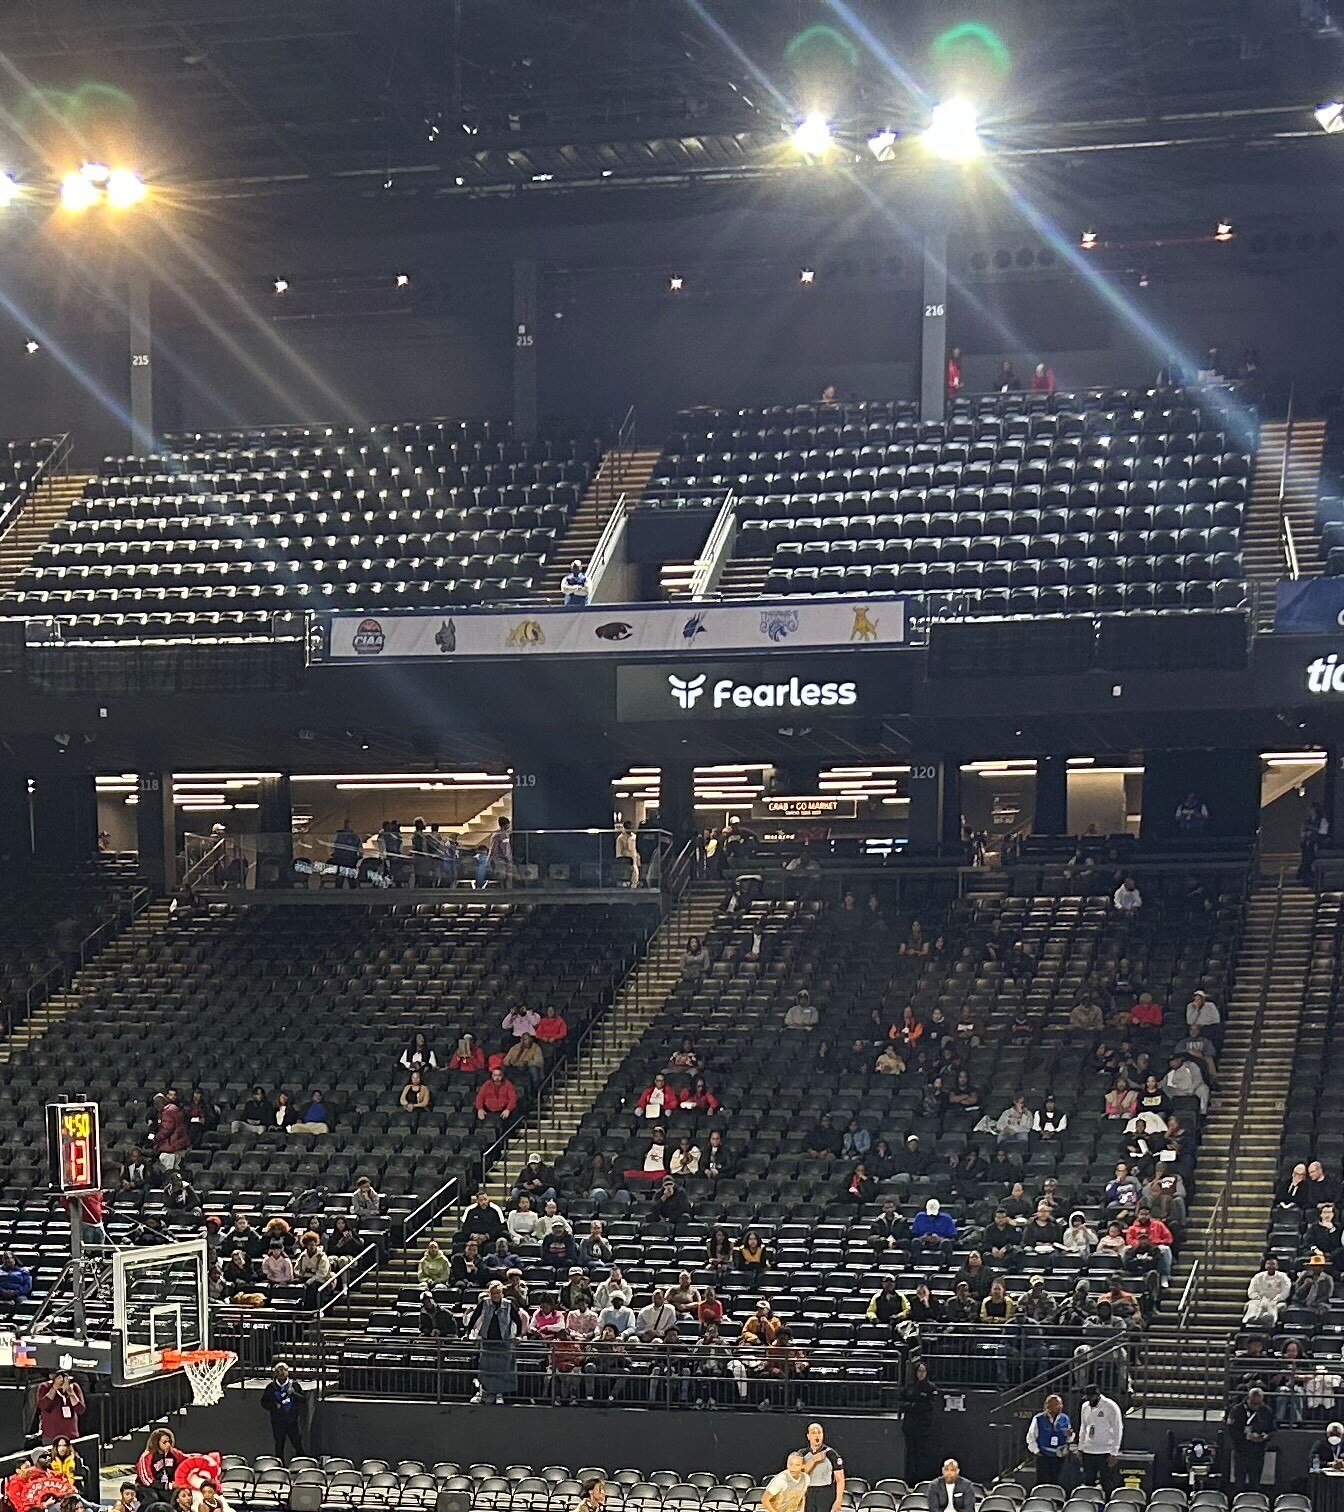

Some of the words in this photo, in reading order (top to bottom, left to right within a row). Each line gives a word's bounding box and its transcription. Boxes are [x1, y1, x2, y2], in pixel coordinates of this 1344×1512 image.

[924, 303, 945, 317] 216
[516, 335, 534, 347] 215
[132, 354, 149, 366] 215
[713, 675, 857, 709] Fearless
[912, 766, 936, 780] 120
[514, 774, 536, 789] 119
[63, 1112, 90, 1138] 4:50
[70, 1139, 88, 1182] 13
